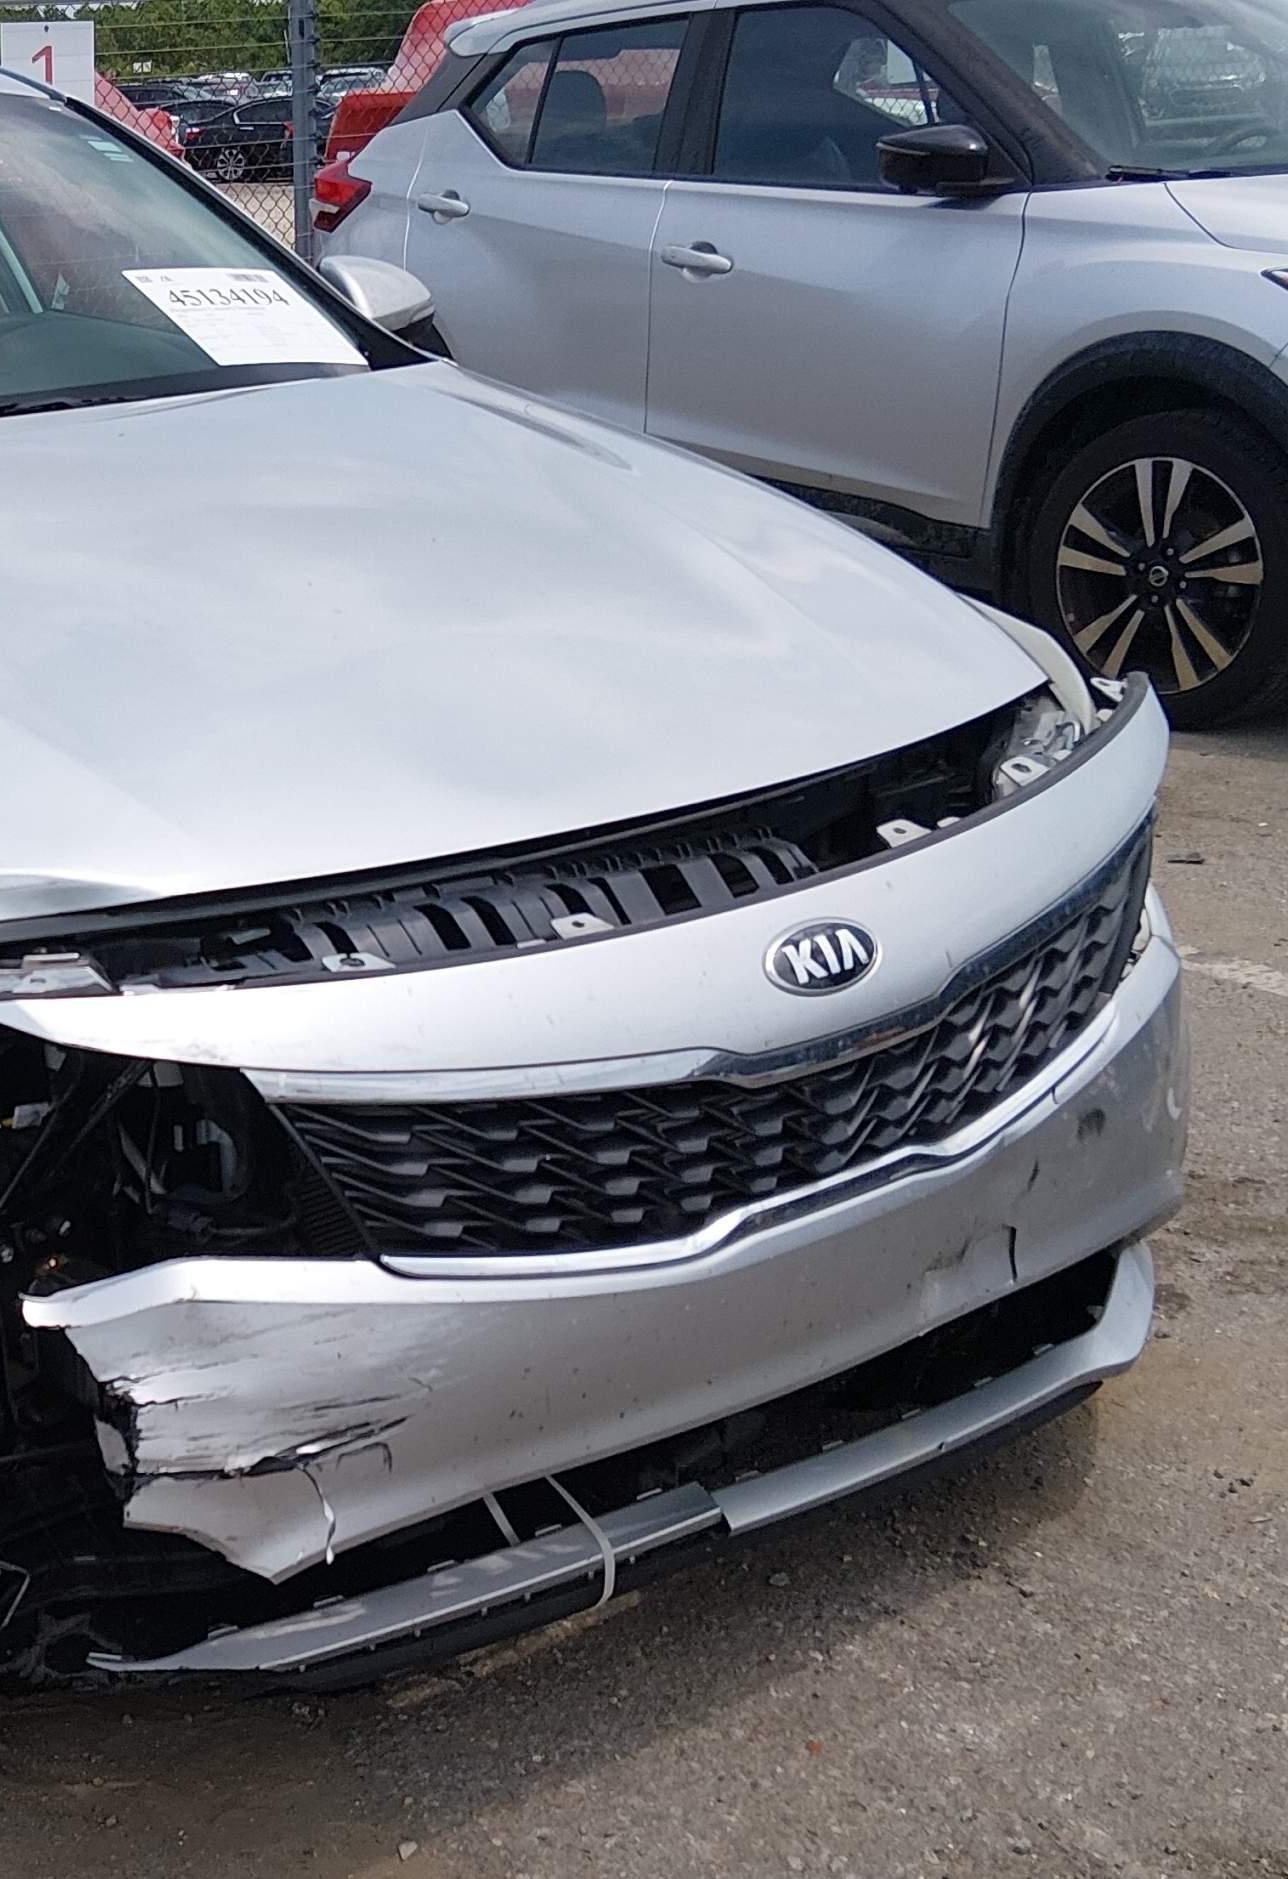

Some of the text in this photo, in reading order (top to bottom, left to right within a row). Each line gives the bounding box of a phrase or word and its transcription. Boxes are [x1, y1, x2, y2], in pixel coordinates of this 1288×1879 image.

[31, 45, 53, 85] 1
[168, 288, 291, 306] 45134194
[781, 928, 870, 985] KIA
